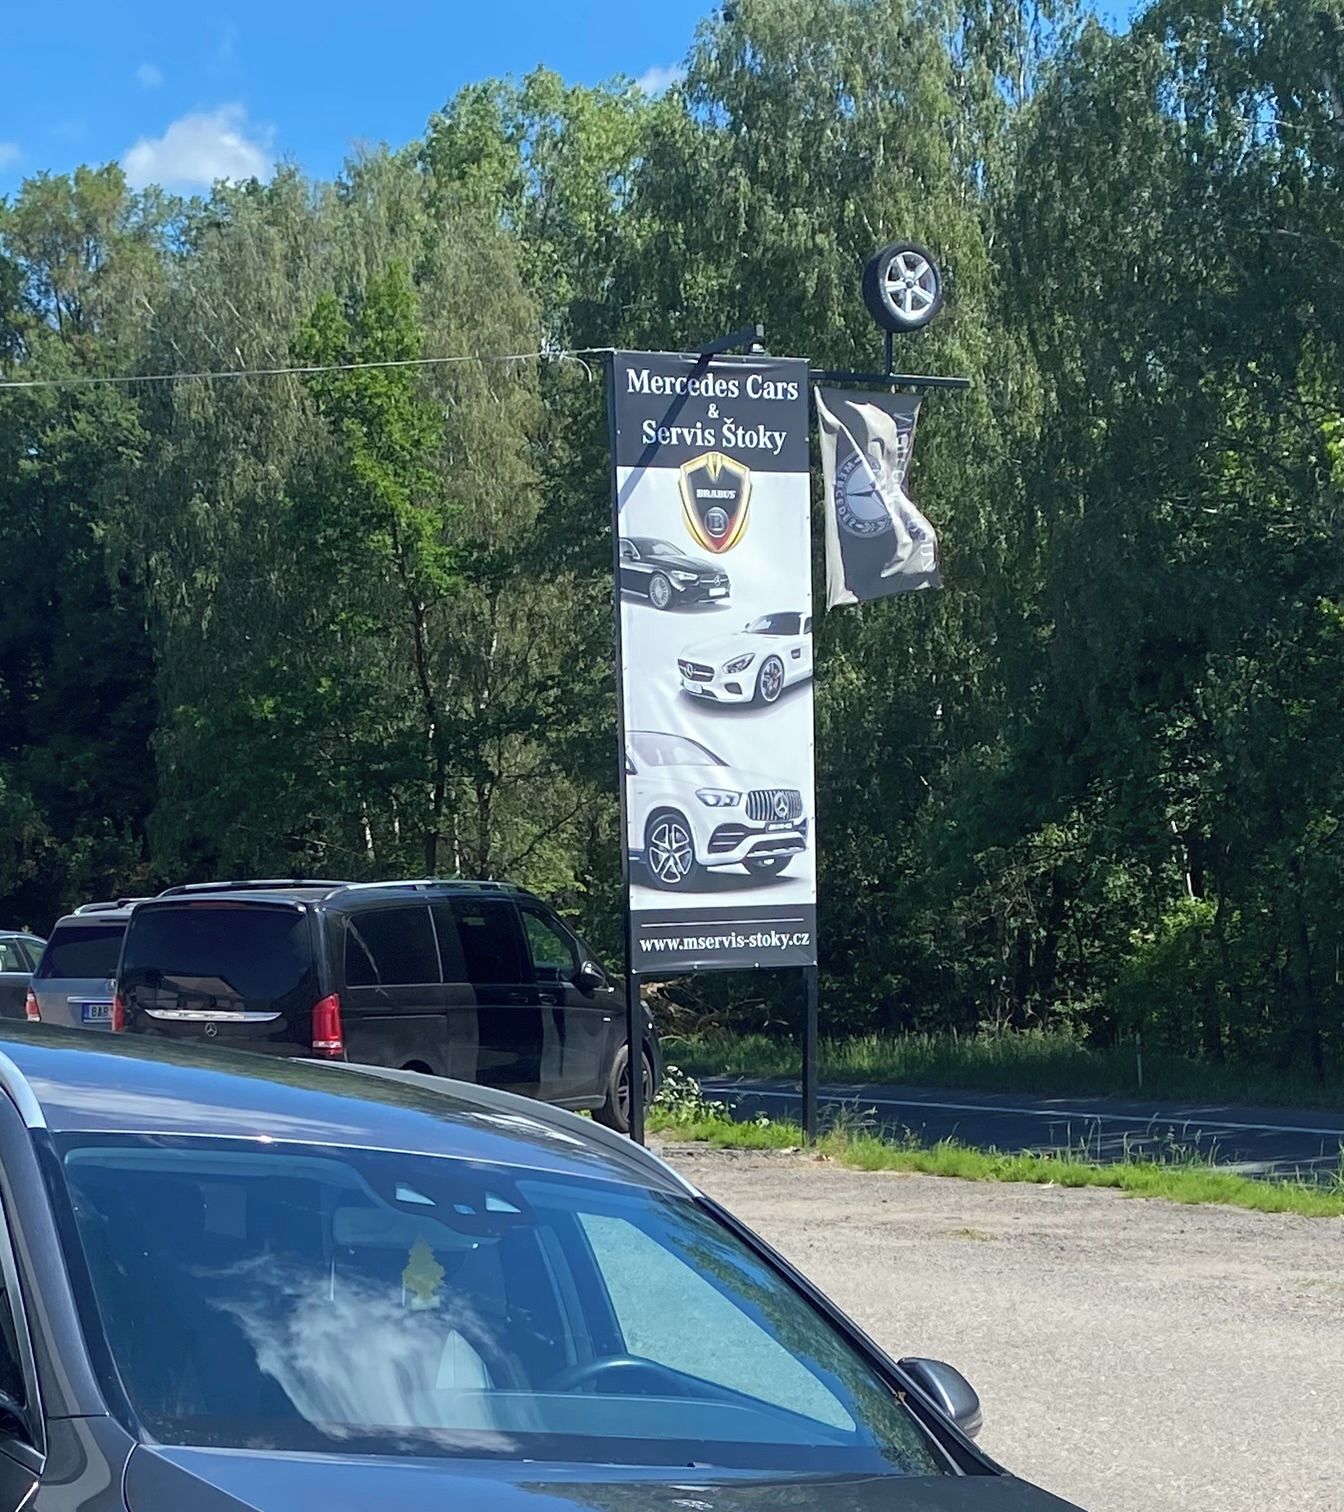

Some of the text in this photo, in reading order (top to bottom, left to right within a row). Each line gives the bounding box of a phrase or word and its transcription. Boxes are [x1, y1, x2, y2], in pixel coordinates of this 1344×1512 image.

[626, 368, 799, 400] Mercedes Cars
[707, 403, 719, 418] &
[642, 418, 787, 455] Servis Štoky
[696, 488, 736, 499] BRABUS
[639, 930, 810, 953] www.mservis-stoky.cz
